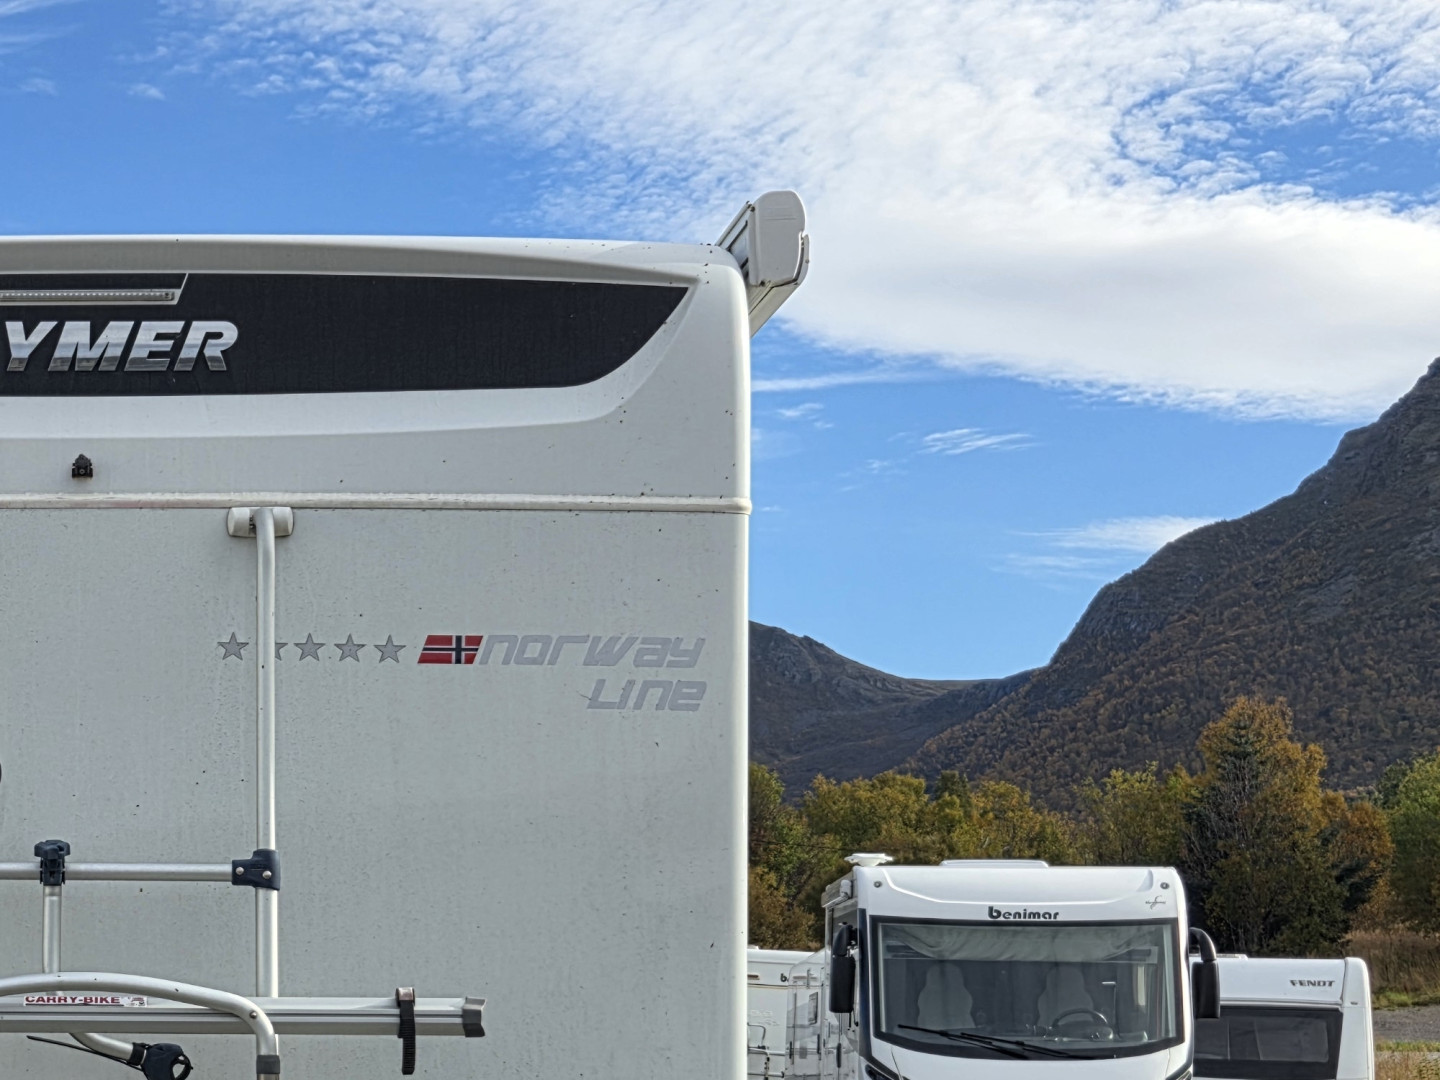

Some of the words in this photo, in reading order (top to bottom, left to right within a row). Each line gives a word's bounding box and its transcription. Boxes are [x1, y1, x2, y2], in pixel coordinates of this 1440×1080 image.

[988, 906, 1059, 920] benimar
[1289, 979, 1336, 987] FENDT
[25, 996, 120, 1004] CARRY-BIKE
